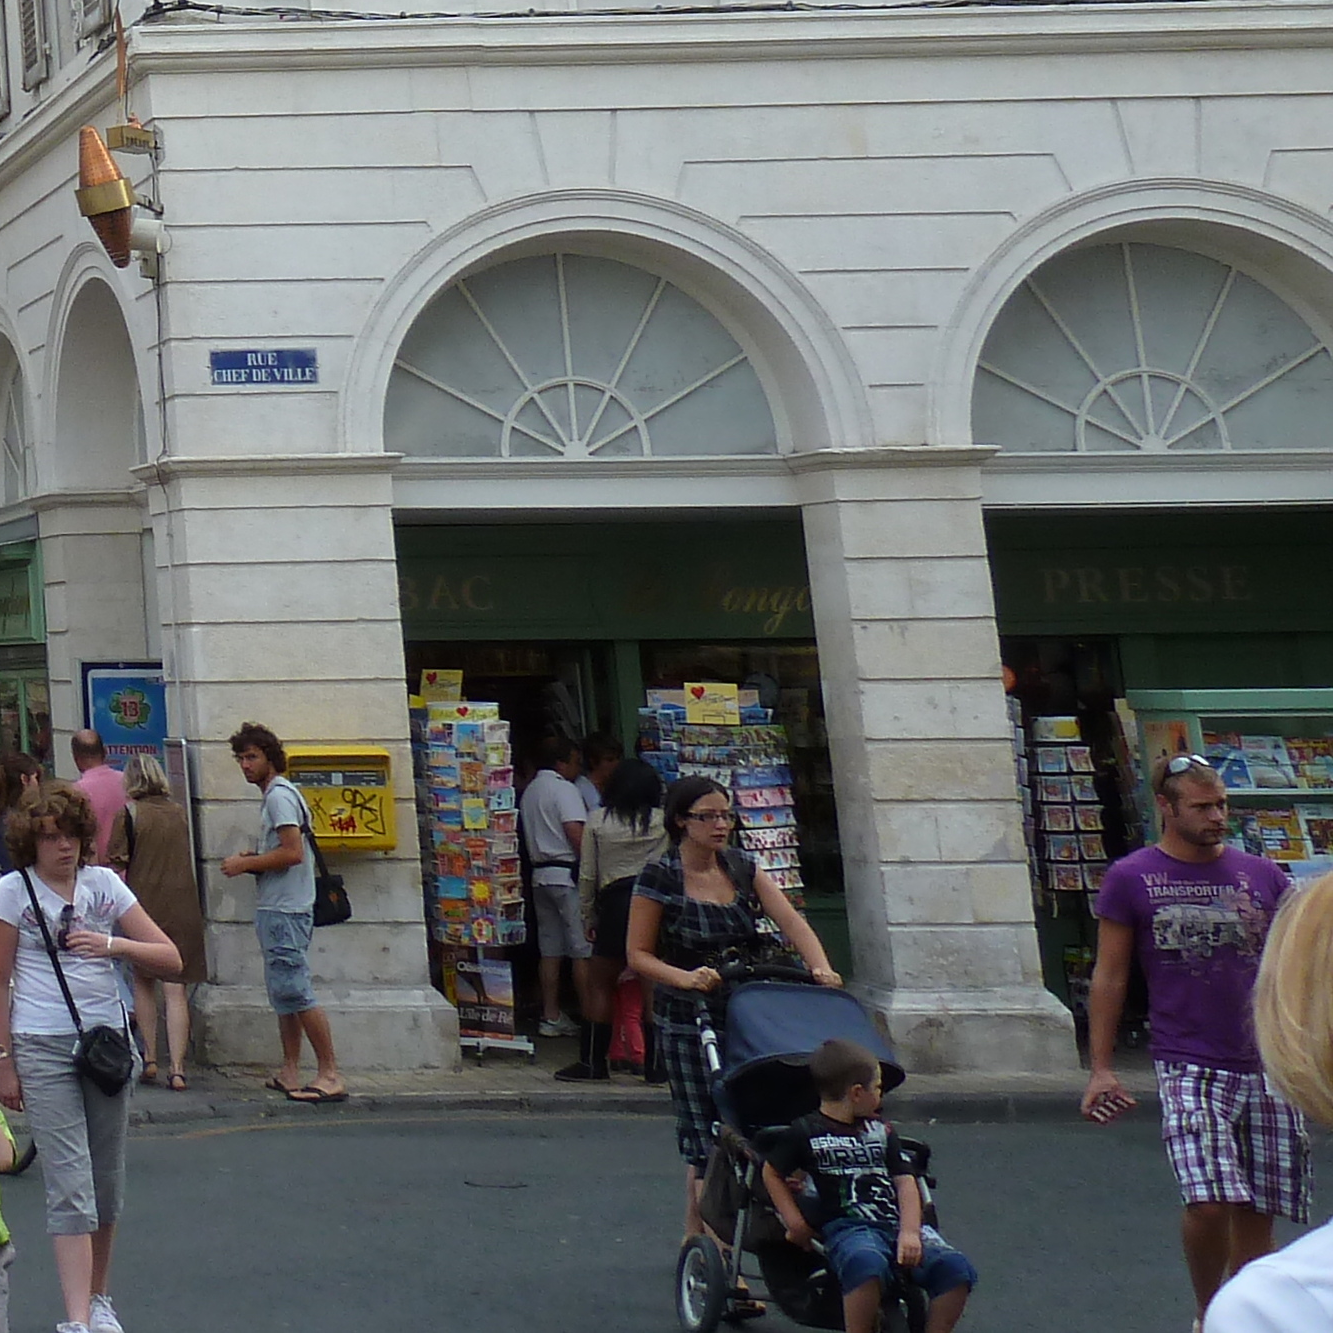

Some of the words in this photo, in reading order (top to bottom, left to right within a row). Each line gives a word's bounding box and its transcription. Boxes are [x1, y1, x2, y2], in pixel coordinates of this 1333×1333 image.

[248, 352, 278, 366] RUE
[213, 369, 250, 382] CHEF
[252, 368, 271, 381] DE
[272, 367, 315, 381] VILLE
[1041, 565, 1253, 603] PRESSE
[120, 701, 139, 717] 13
[1140, 871, 1168, 886] VW
[1146, 884, 1235, 898] TRANSPORTER
